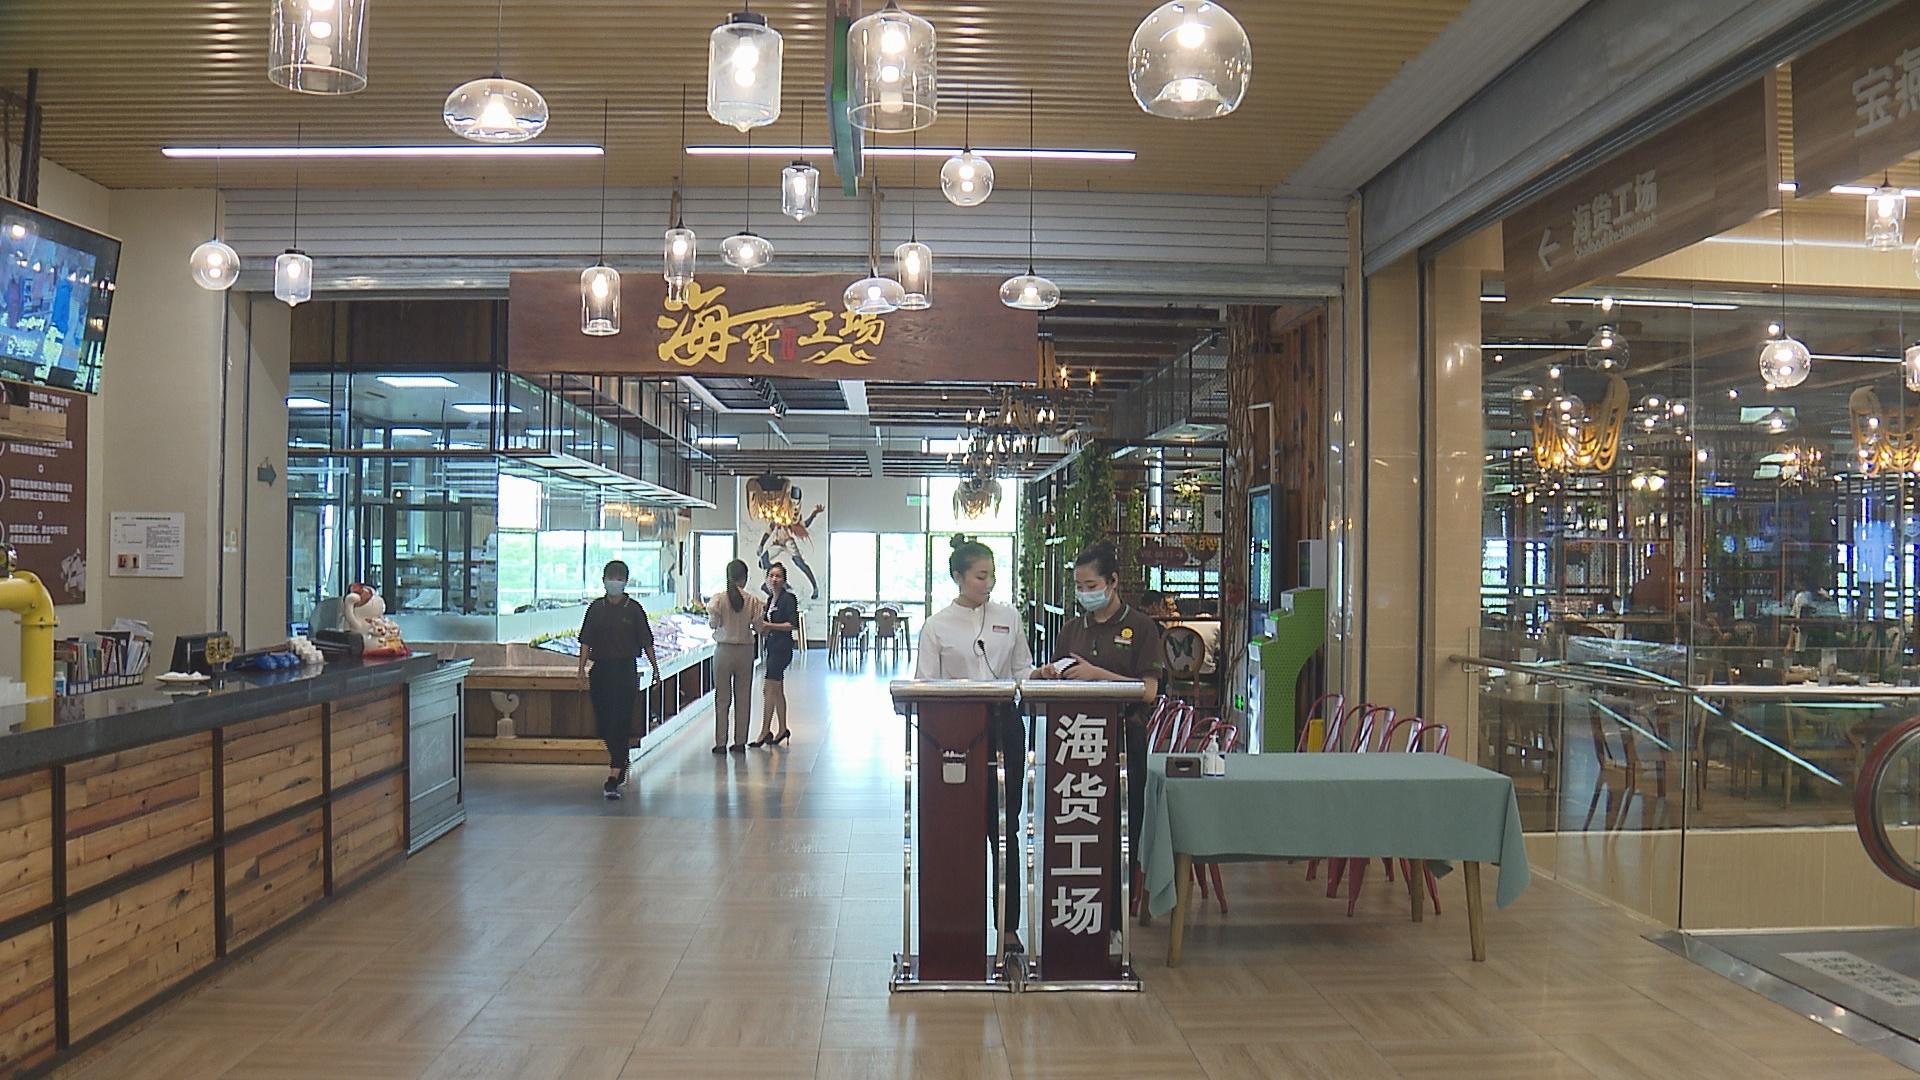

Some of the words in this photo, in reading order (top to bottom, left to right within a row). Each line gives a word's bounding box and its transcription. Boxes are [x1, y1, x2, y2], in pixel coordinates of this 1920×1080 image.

[1572, 170, 1658, 247] 海货工场
[1050, 713, 1109, 936] 海货工场
